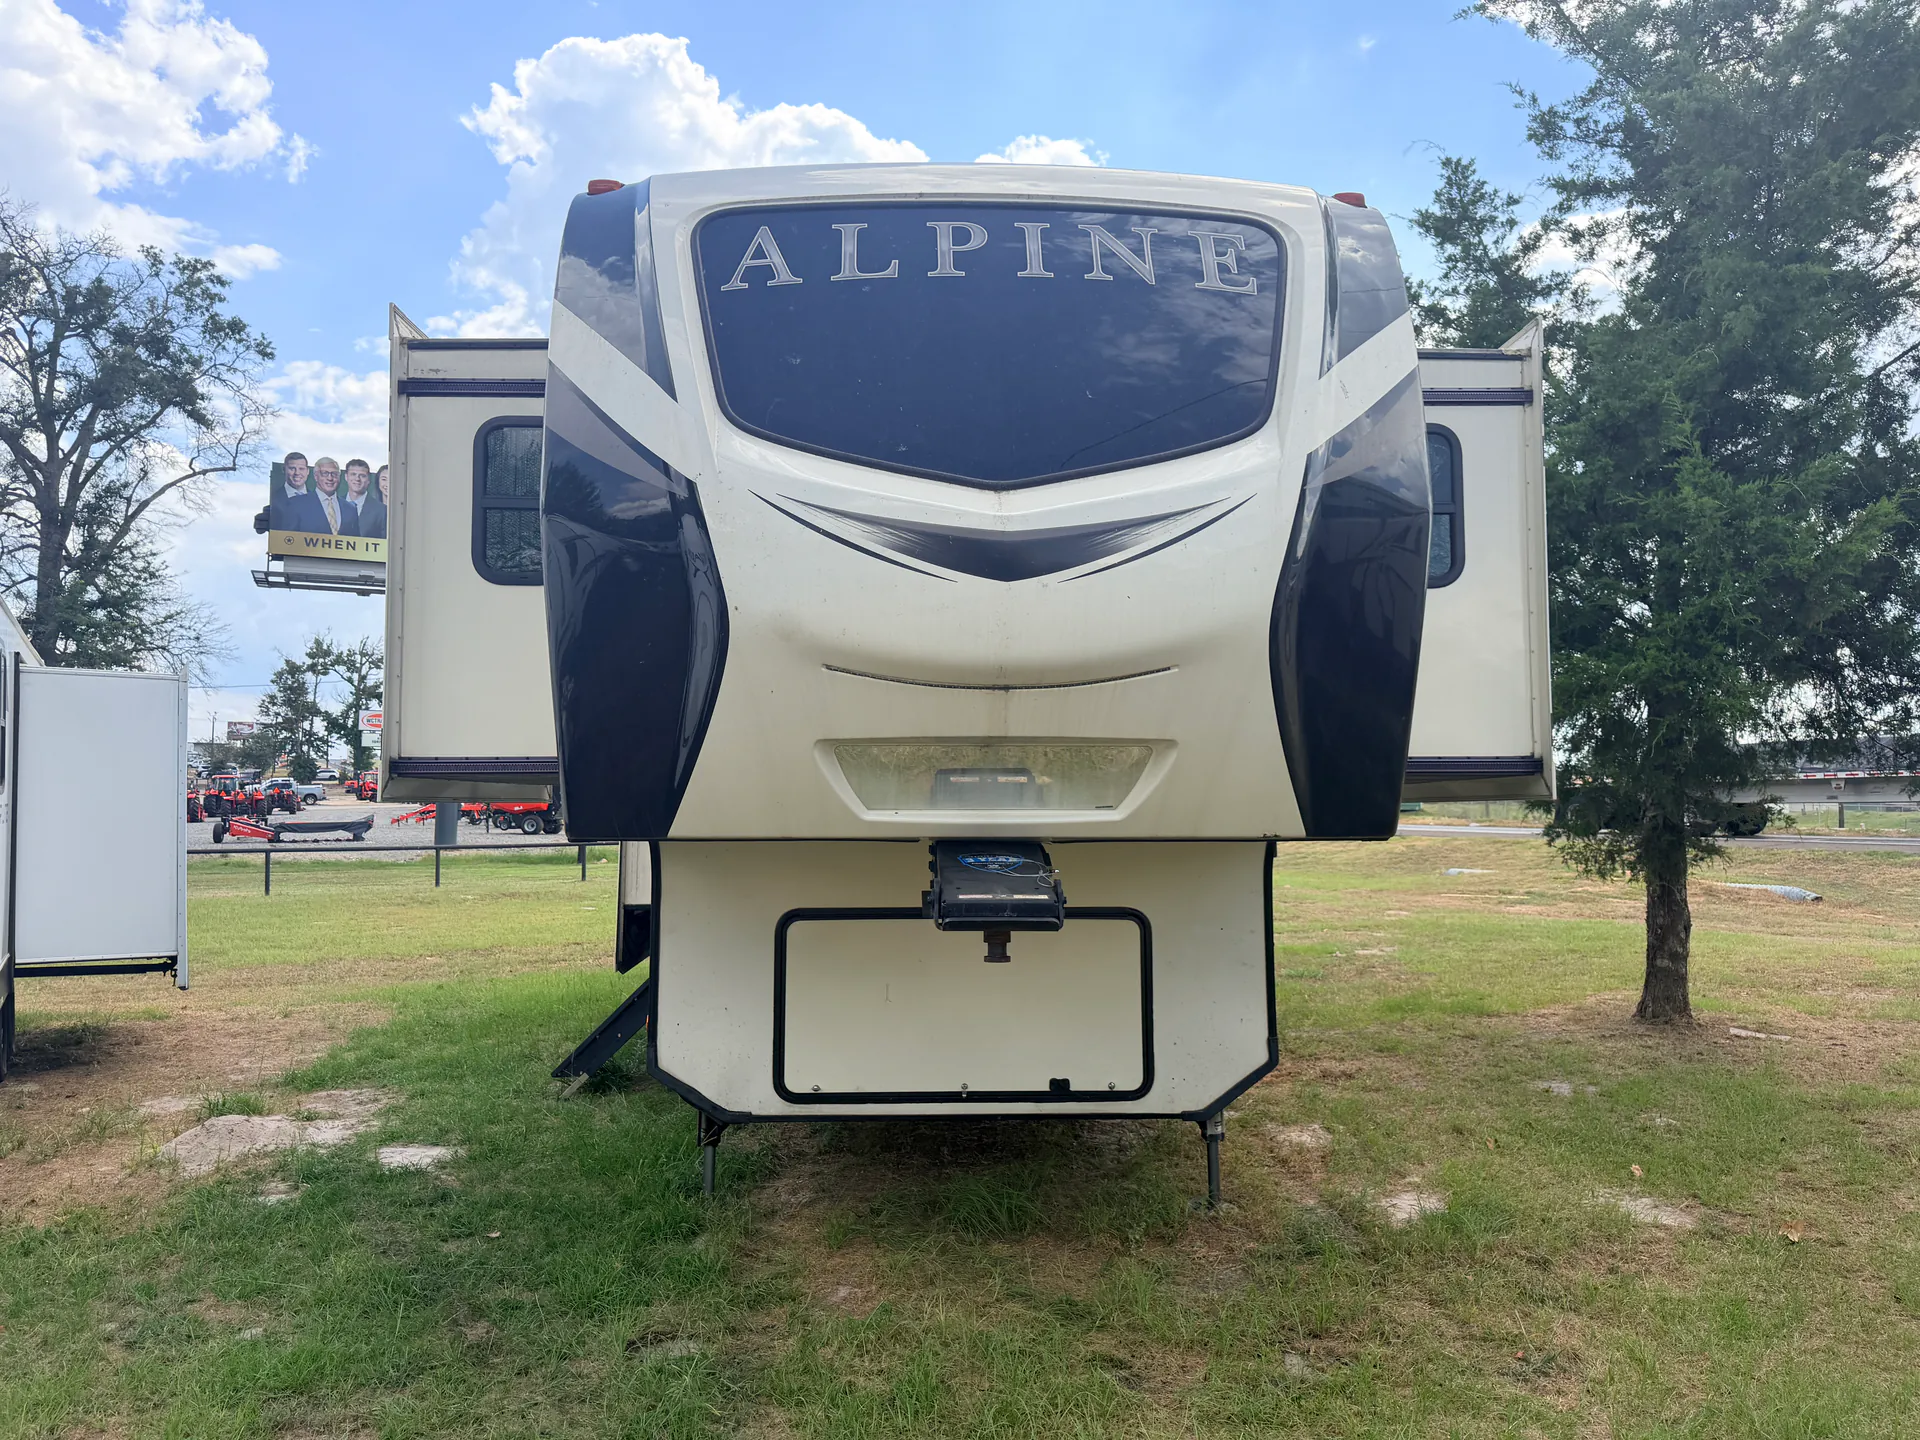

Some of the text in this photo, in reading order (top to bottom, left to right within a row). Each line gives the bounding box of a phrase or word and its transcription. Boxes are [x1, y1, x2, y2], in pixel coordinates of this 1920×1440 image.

[720, 221, 1258, 296] ALPINE
[303, 537, 380, 553] WHEN IT
